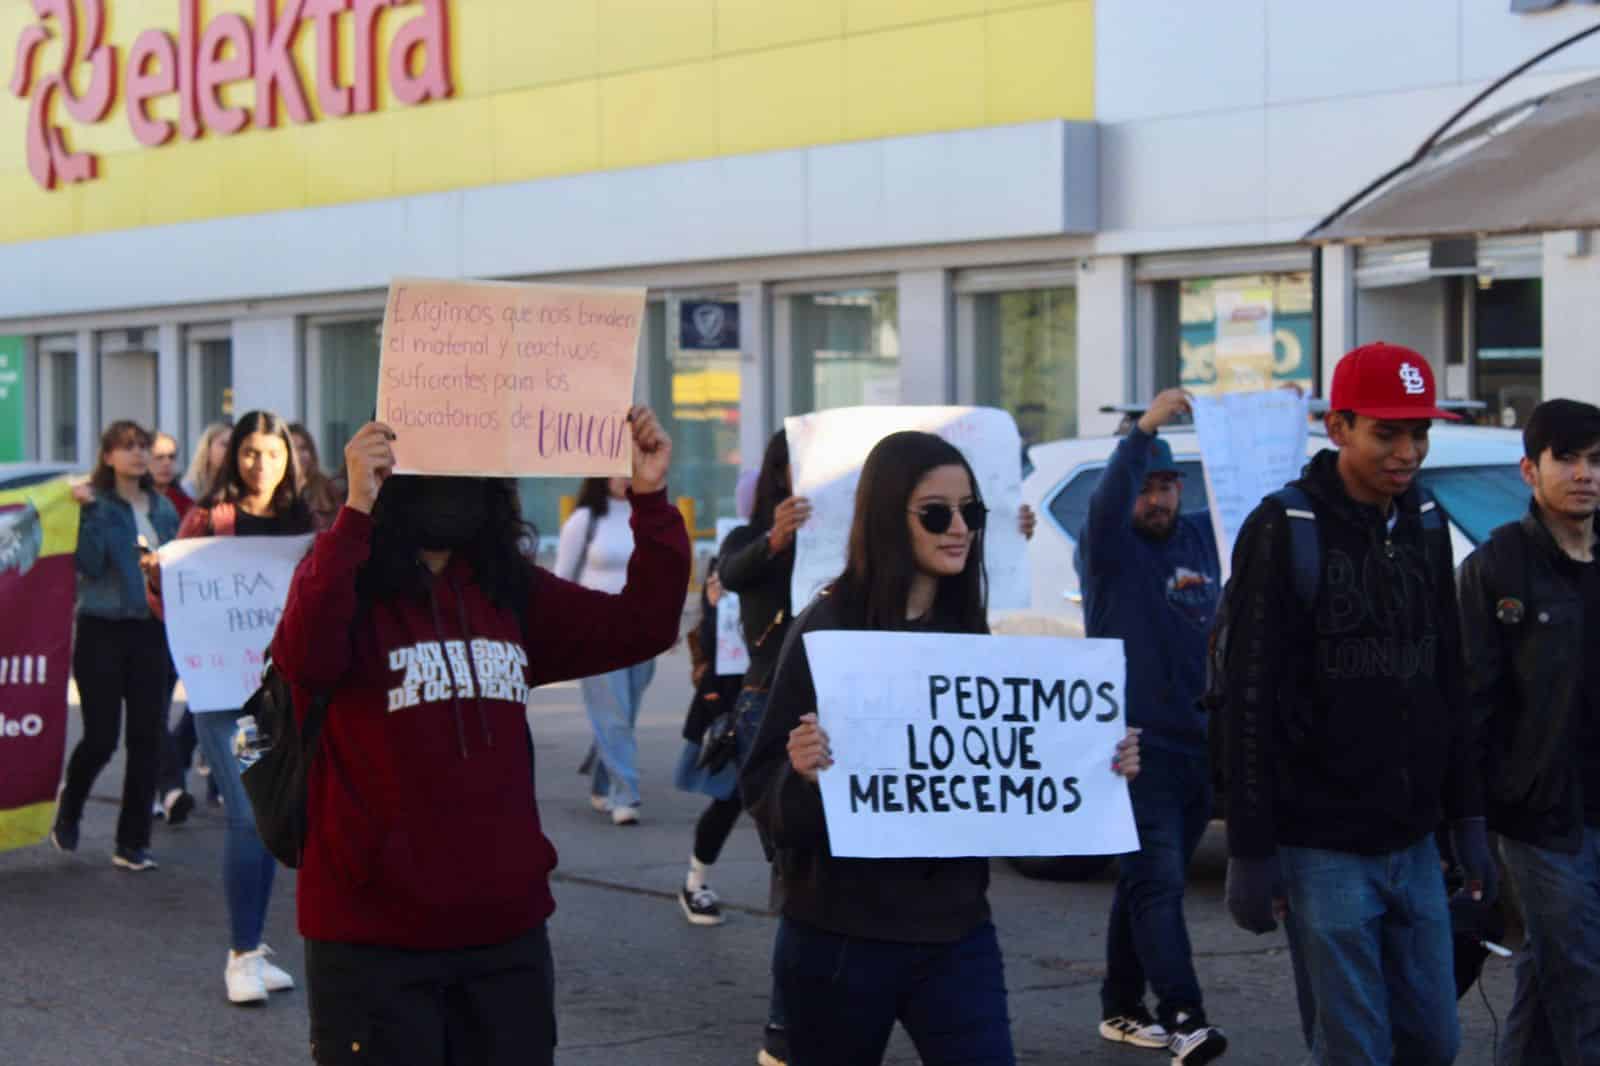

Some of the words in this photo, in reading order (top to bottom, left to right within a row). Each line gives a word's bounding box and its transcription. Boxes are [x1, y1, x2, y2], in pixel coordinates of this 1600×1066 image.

[126, 0, 457, 147] elektra
[393, 287, 496, 331] Exigimos
[501, 305, 533, 334] que
[540, 304, 571, 325] nos
[390, 335, 406, 353] el
[413, 334, 489, 357] material
[515, 336, 602, 361] reactivos
[493, 372, 534, 399] para
[544, 364, 570, 393] los
[385, 396, 500, 431] laboratorios
[510, 402, 535, 431] de
[928, 674, 1120, 723] PEDIMOS
[907, 724, 955, 770] LO
[962, 726, 1041, 771] QUE
[849, 774, 1083, 815] MERECEMOS
